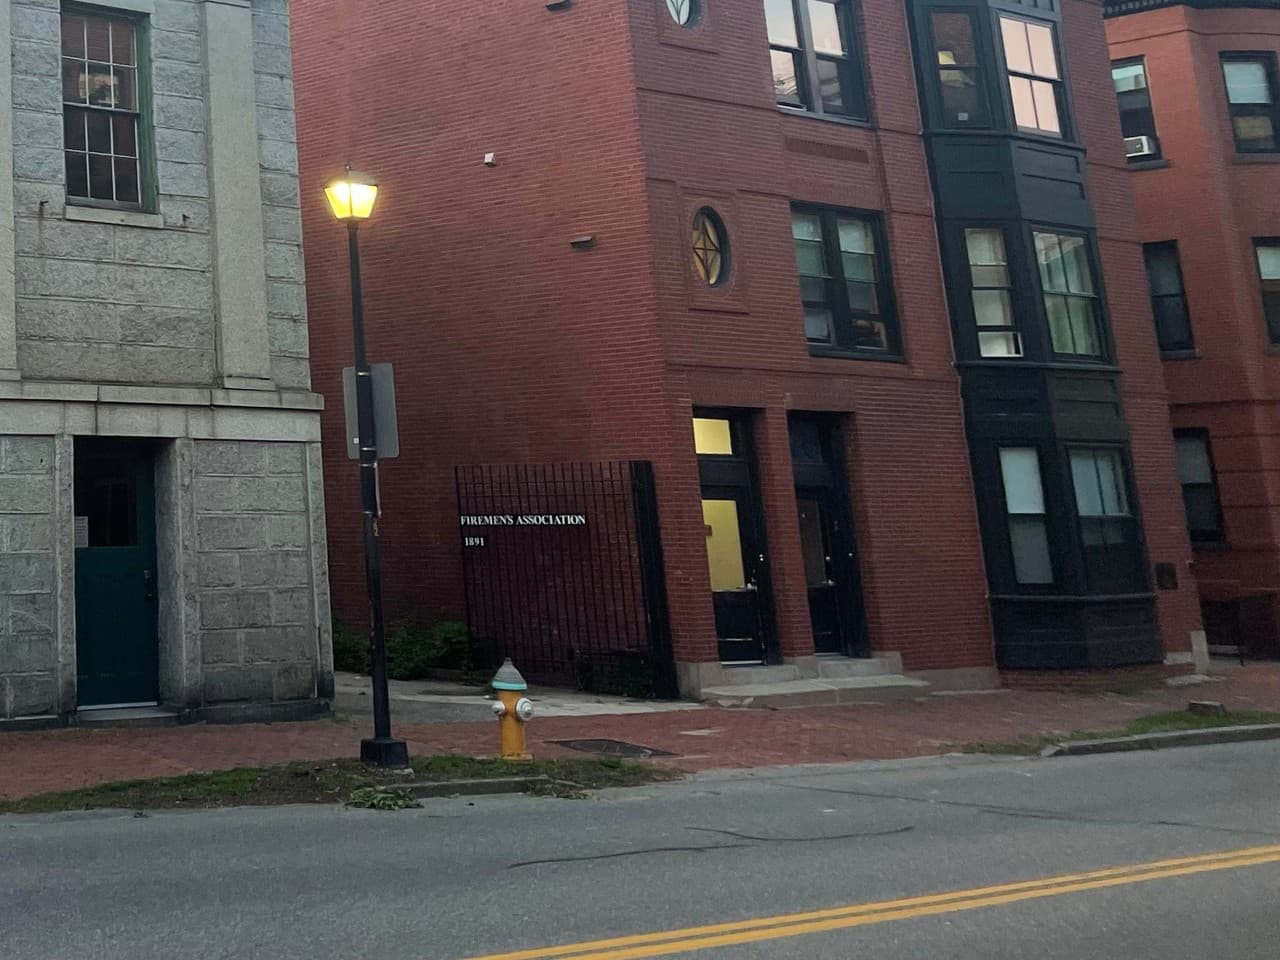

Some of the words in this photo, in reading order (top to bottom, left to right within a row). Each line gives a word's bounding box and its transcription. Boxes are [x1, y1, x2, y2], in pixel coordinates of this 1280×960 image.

[460, 515, 514, 525] FIREMEN'S
[516, 514, 586, 525] ASSOCIATION
[464, 537, 485, 546] 1891
